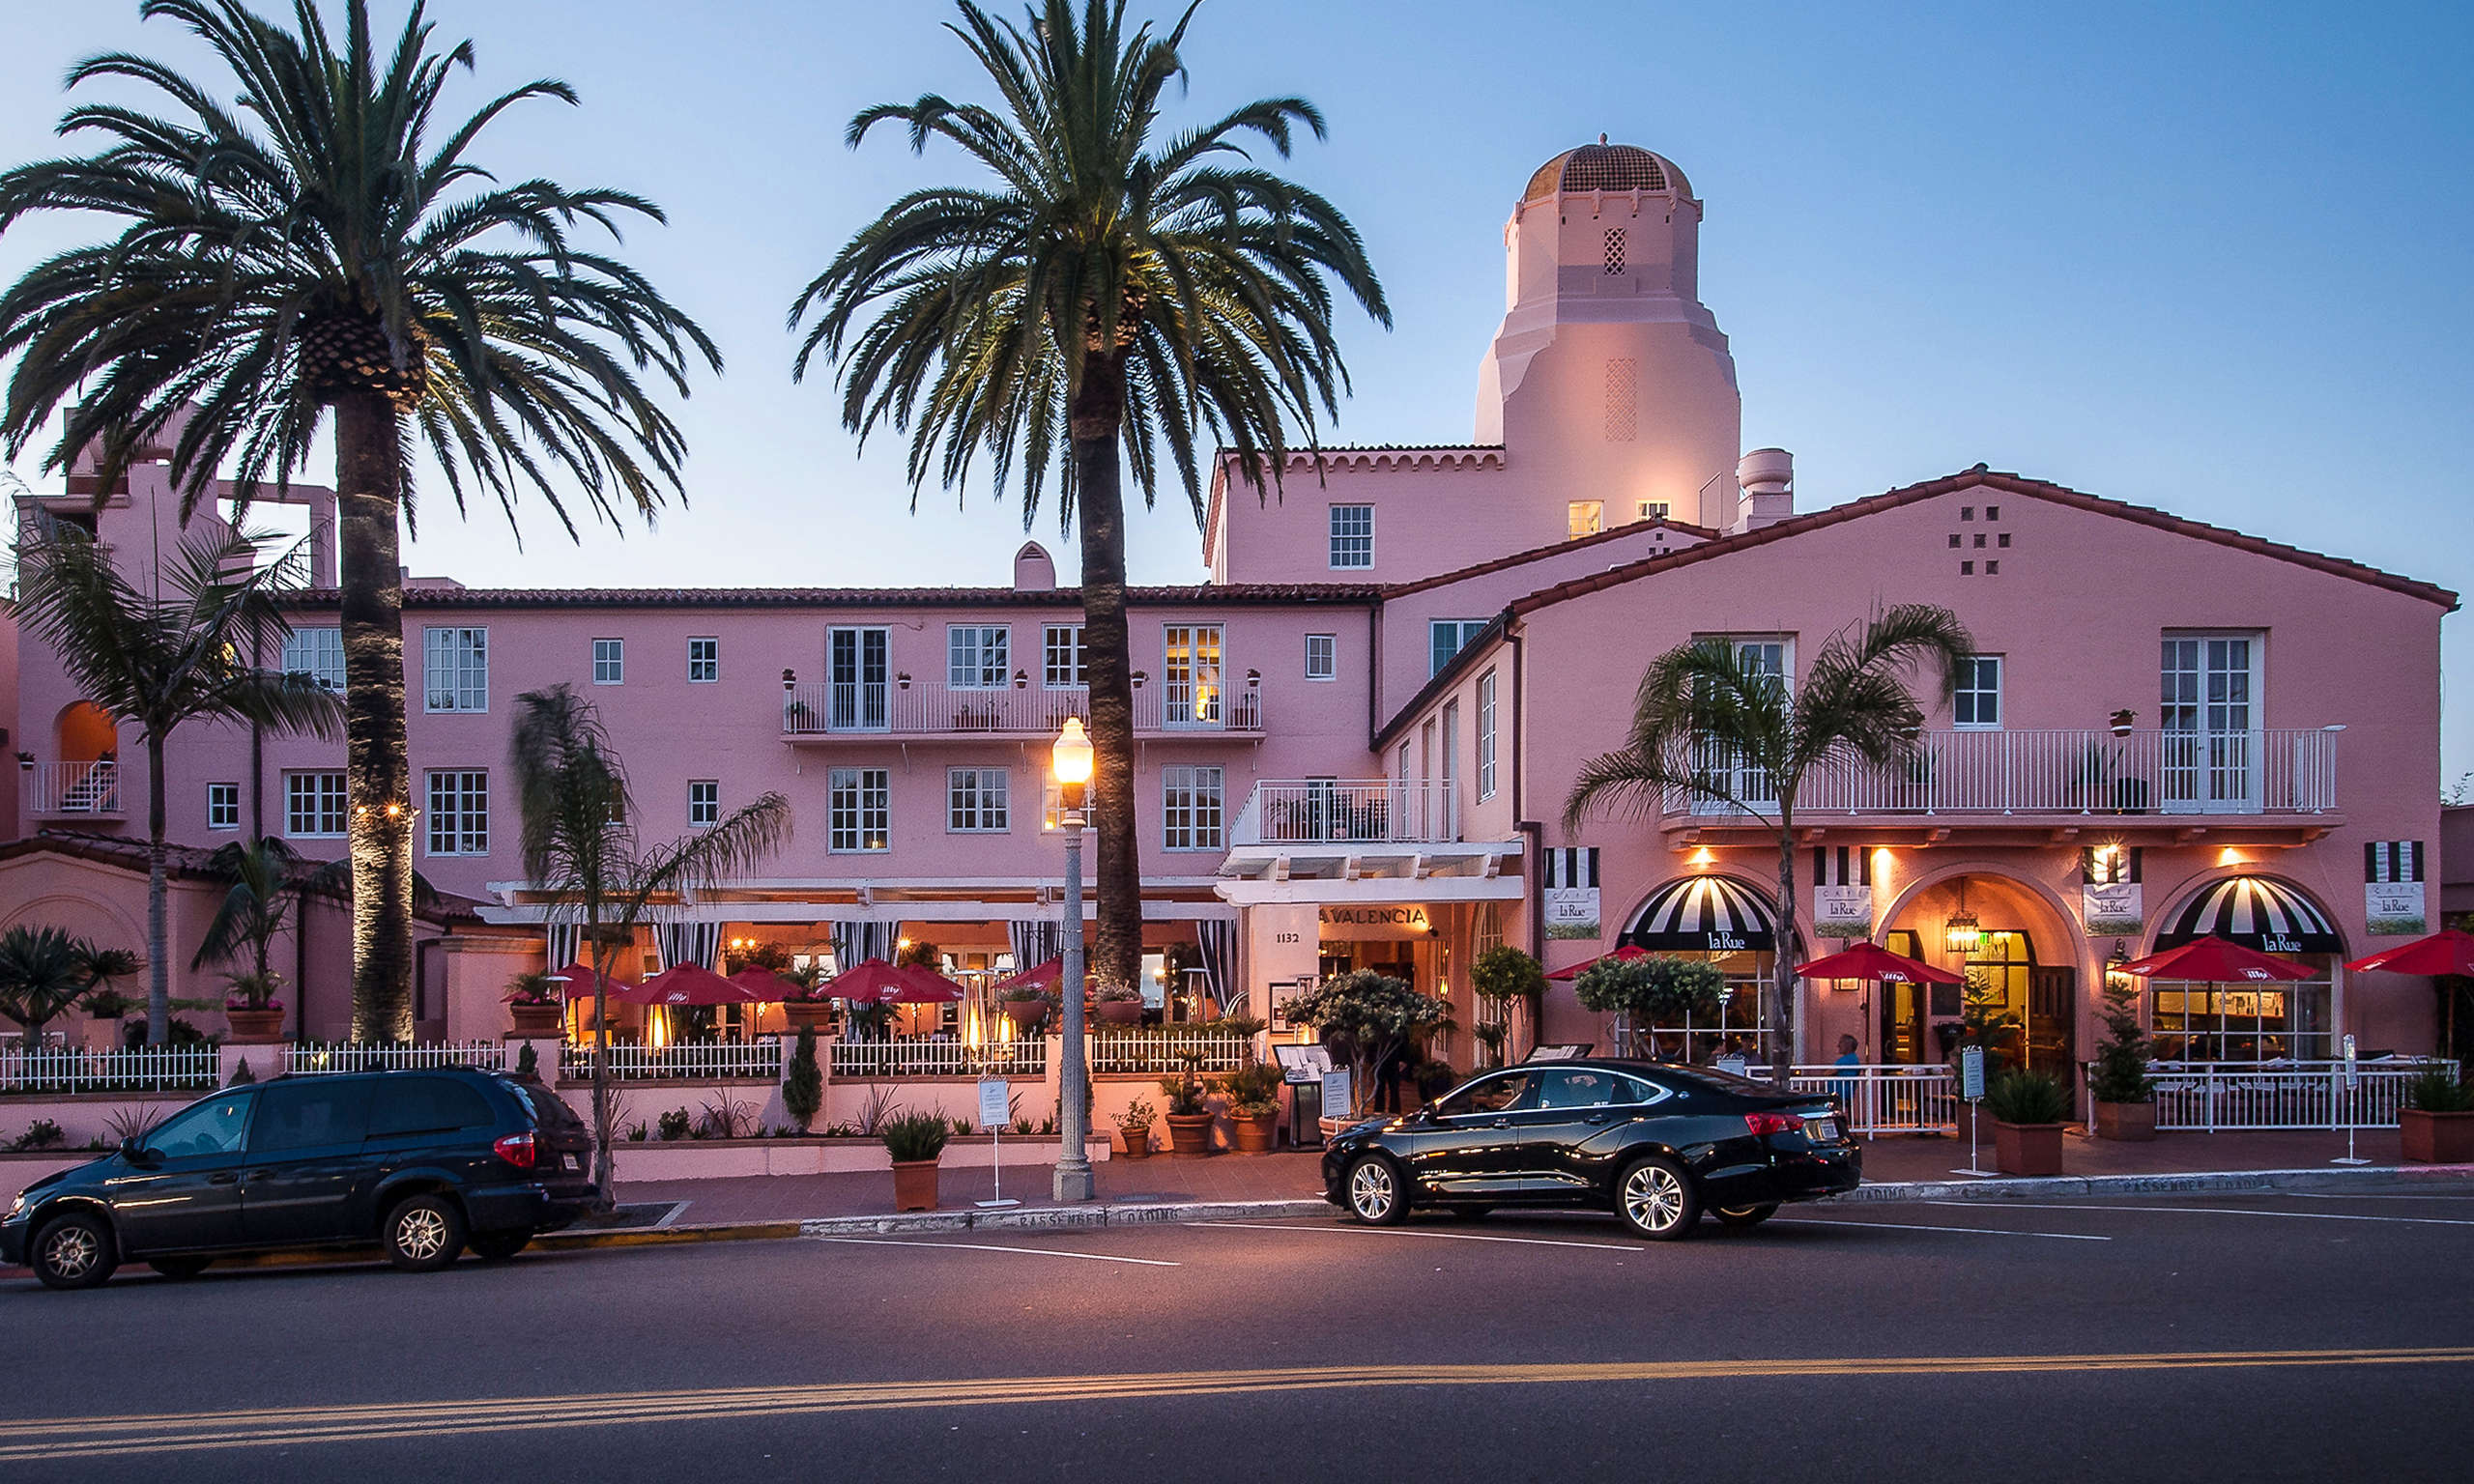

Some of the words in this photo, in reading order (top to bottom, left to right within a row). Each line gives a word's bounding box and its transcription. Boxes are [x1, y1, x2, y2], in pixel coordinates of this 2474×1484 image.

[1330, 908, 1425, 924] VALENCIA
[1277, 933, 1300, 943] 1132
[1856, 1187, 1906, 1200] OADING
[1020, 1213, 1107, 1227] PASSENGER
[1117, 1208, 1178, 1222] LOADING
